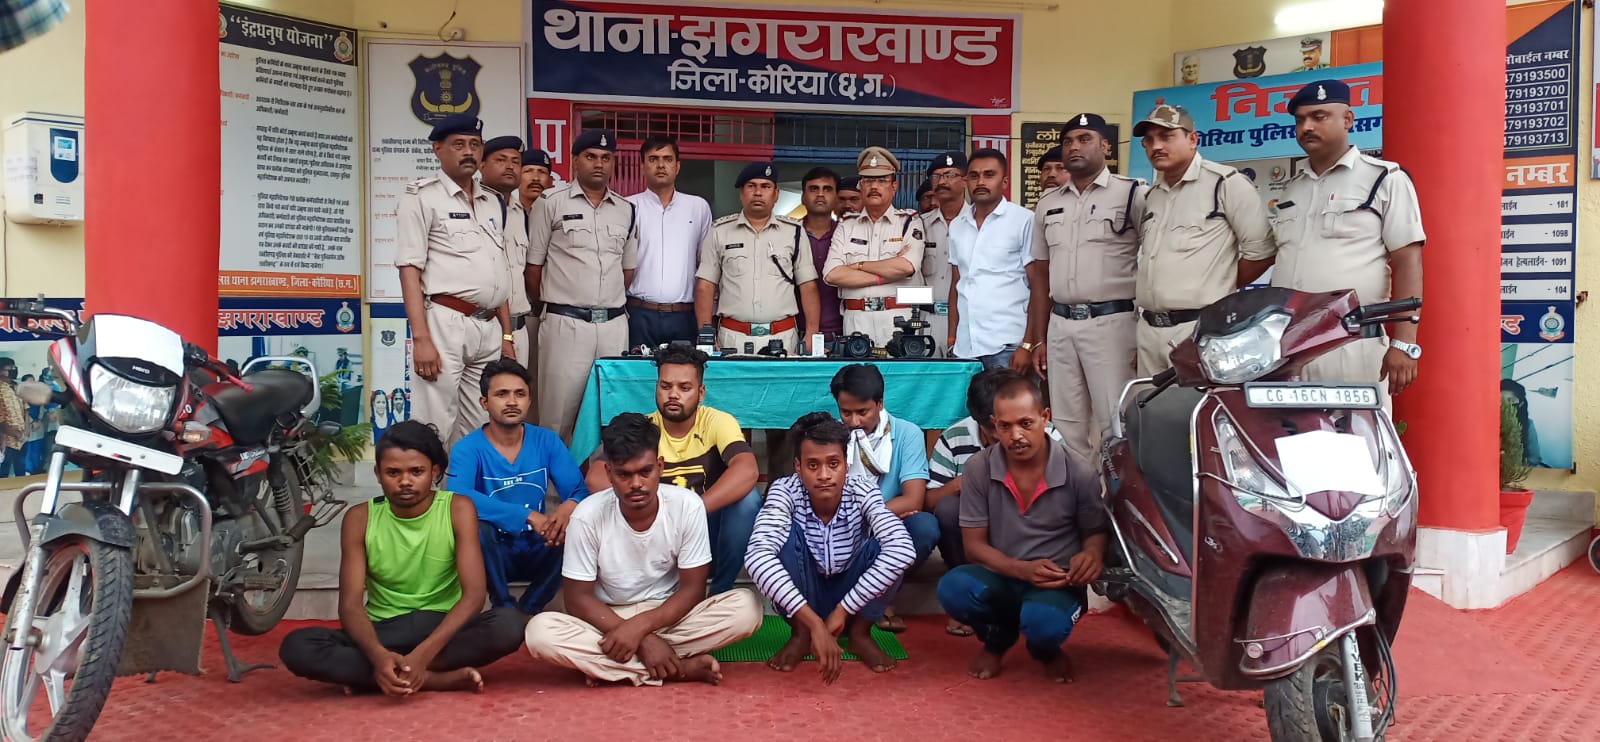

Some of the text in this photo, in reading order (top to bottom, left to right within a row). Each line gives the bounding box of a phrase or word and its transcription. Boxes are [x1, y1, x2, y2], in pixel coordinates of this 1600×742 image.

[544, 8, 1002, 66] थाना-झगराखाण्ड
[1211, 75, 1383, 122] नित
[1506, 163, 1570, 185] नम्बर
[1501, 228, 1515, 239] ाईन
[232, 276, 248, 286] थाना
[1501, 315, 1525, 335] ड
[1266, 390, 1370, 402] CG 16CN 1856
